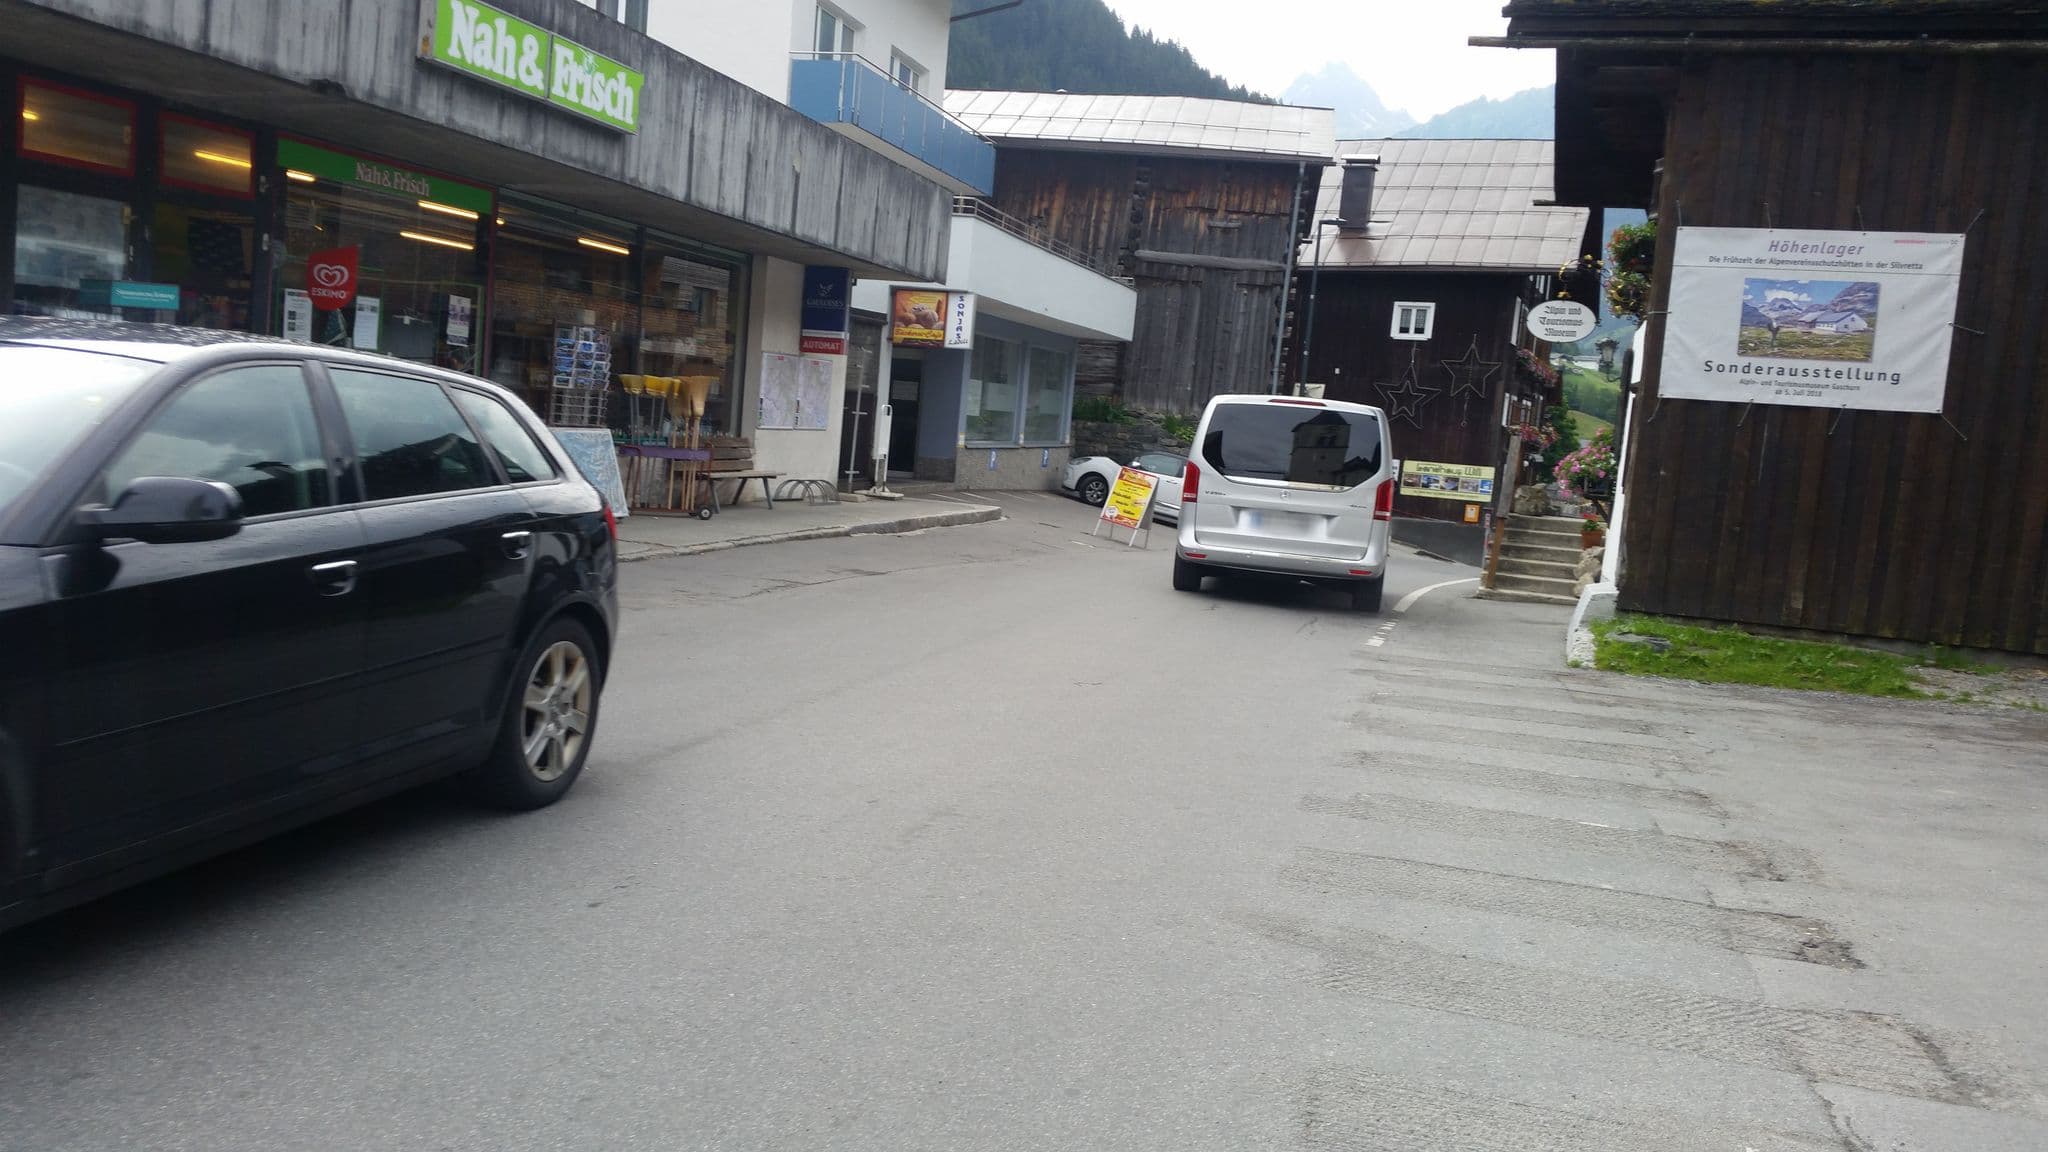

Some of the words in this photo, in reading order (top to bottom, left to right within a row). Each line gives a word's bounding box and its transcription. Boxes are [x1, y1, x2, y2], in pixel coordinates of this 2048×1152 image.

[551, 43, 635, 125] Frisch
[1768, 240, 1864, 257] Höhenlager
[1709, 255, 1721, 263] Die
[1723, 256, 1753, 265] Frühzeit
[1755, 257, 1768, 265] der
[1876, 261, 1889, 269] der
[1890, 261, 1923, 270] Silvretta
[311, 287, 347, 299] ESKIMO
[803, 341, 840, 350] AUTOMAT
[1703, 359, 1901, 385] Sonderausstellung
